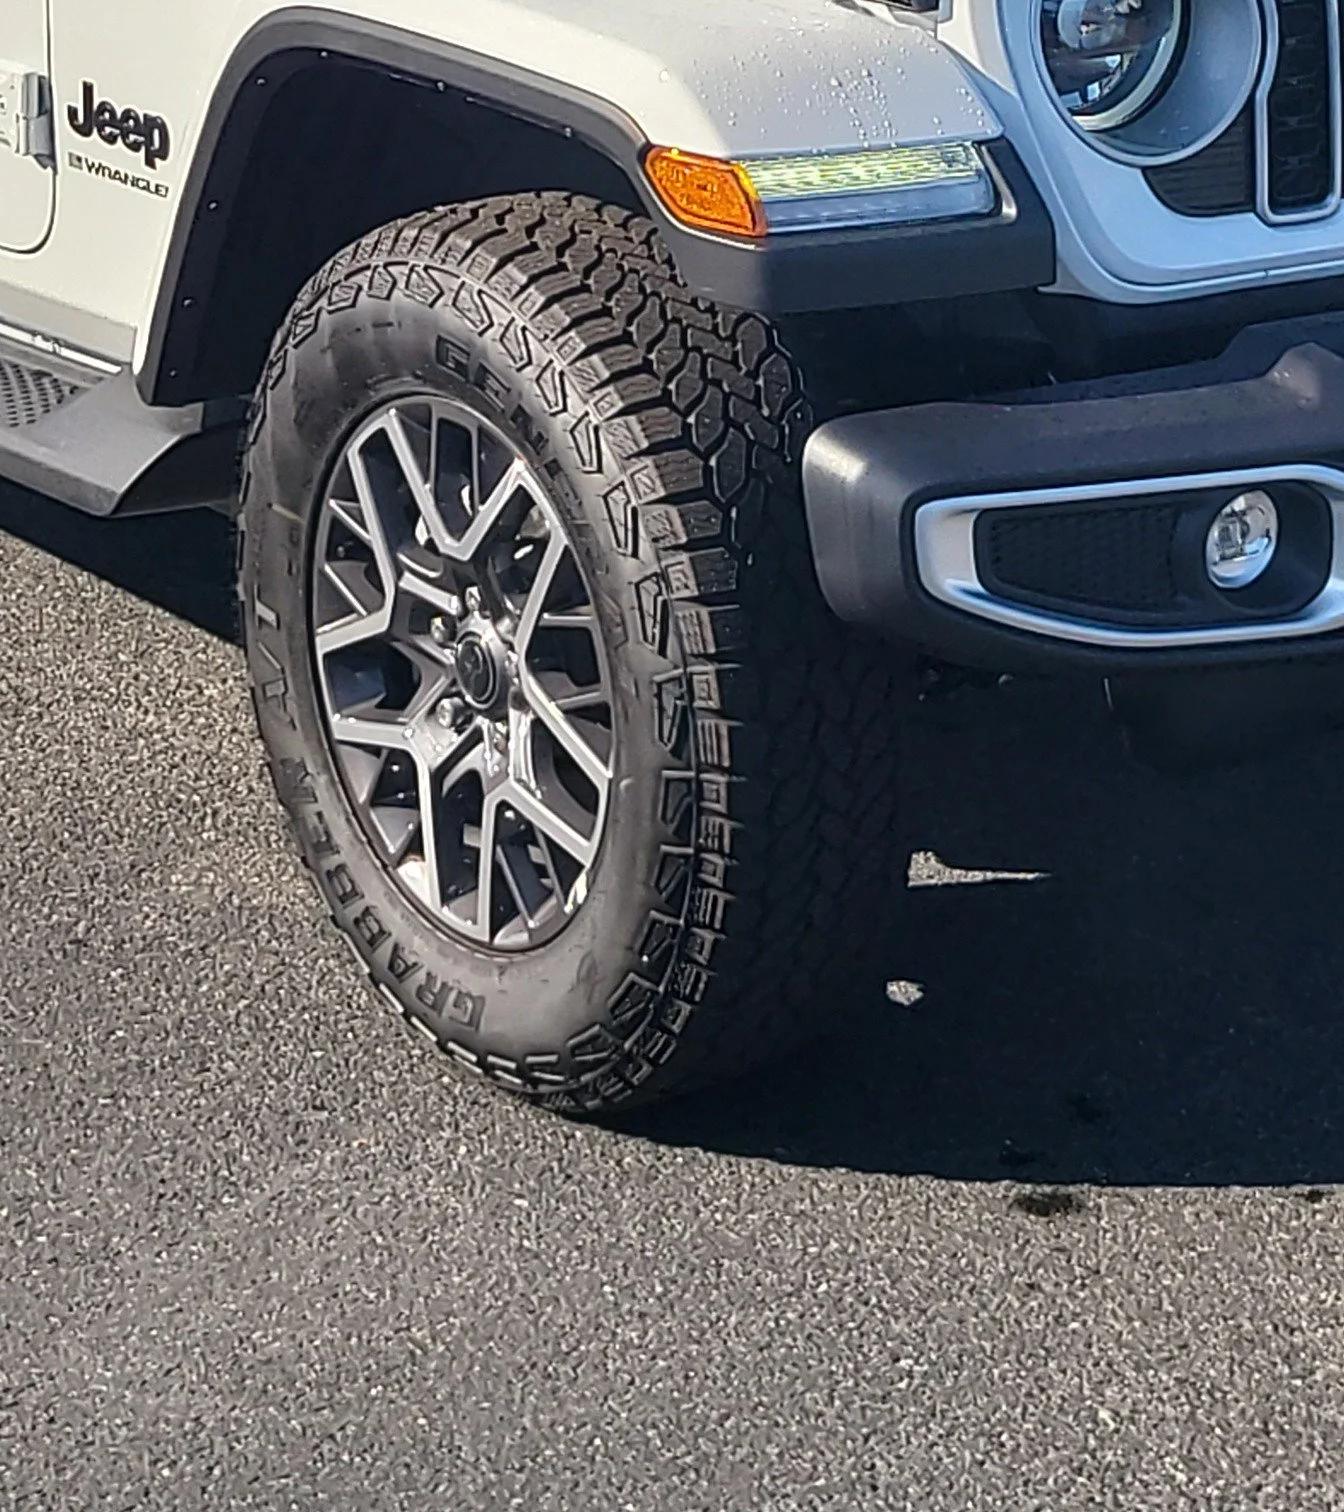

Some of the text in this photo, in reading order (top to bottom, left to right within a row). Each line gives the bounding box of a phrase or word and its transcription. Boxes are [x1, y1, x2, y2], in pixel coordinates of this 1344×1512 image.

[67, 80, 170, 171] Jeep
[85, 157, 170, 199] WRANGLER
[278, 756, 485, 1032] GRABBER
